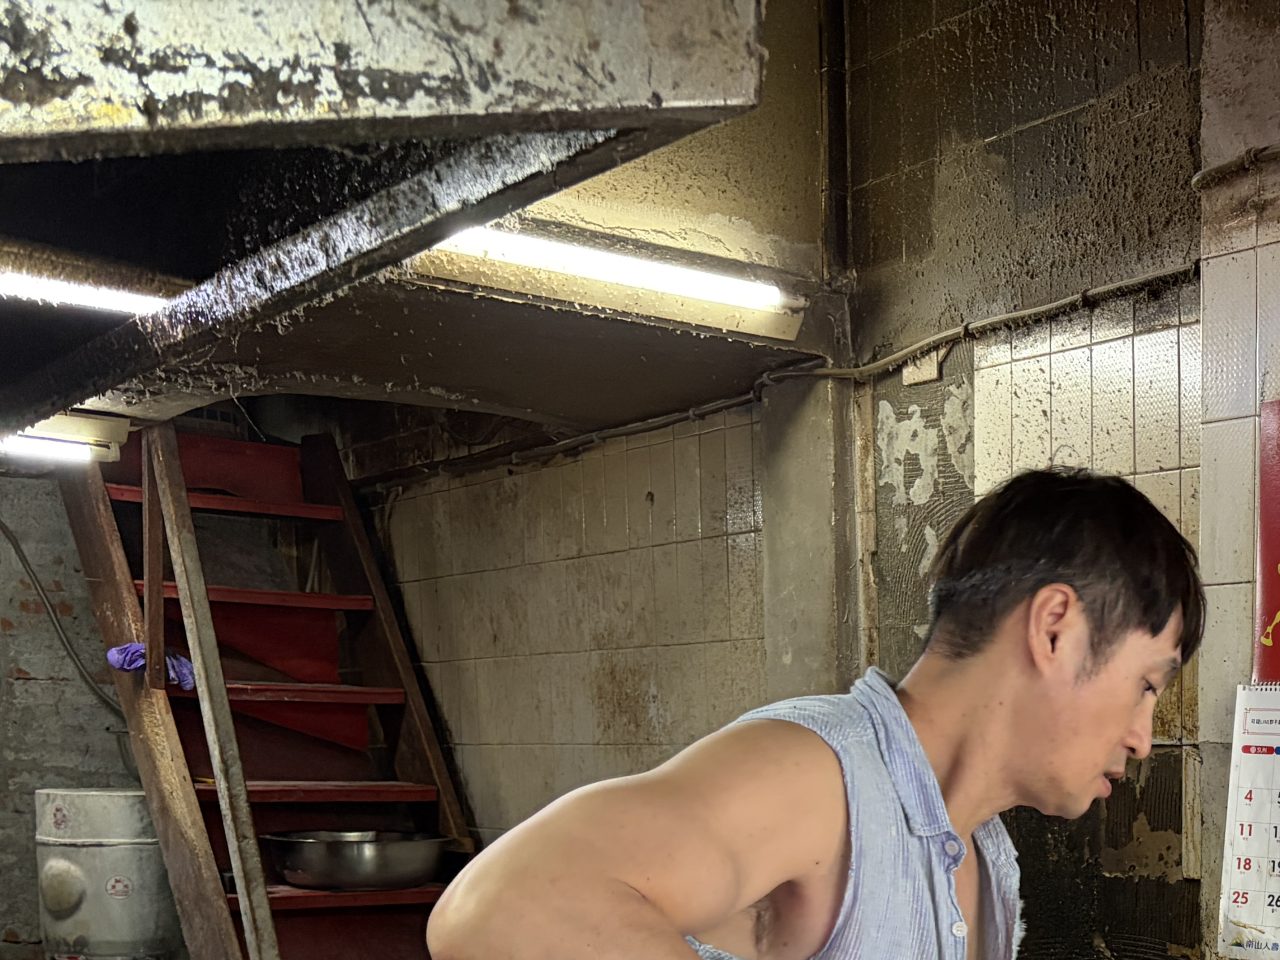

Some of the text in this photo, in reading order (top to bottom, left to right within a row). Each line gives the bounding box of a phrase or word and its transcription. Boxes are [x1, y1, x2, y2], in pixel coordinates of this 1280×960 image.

[1243, 789, 1254, 803] 4
[1239, 823, 1253, 837] 11
[1236, 856, 1252, 872] 18
[1231, 890, 1249, 905] 25
